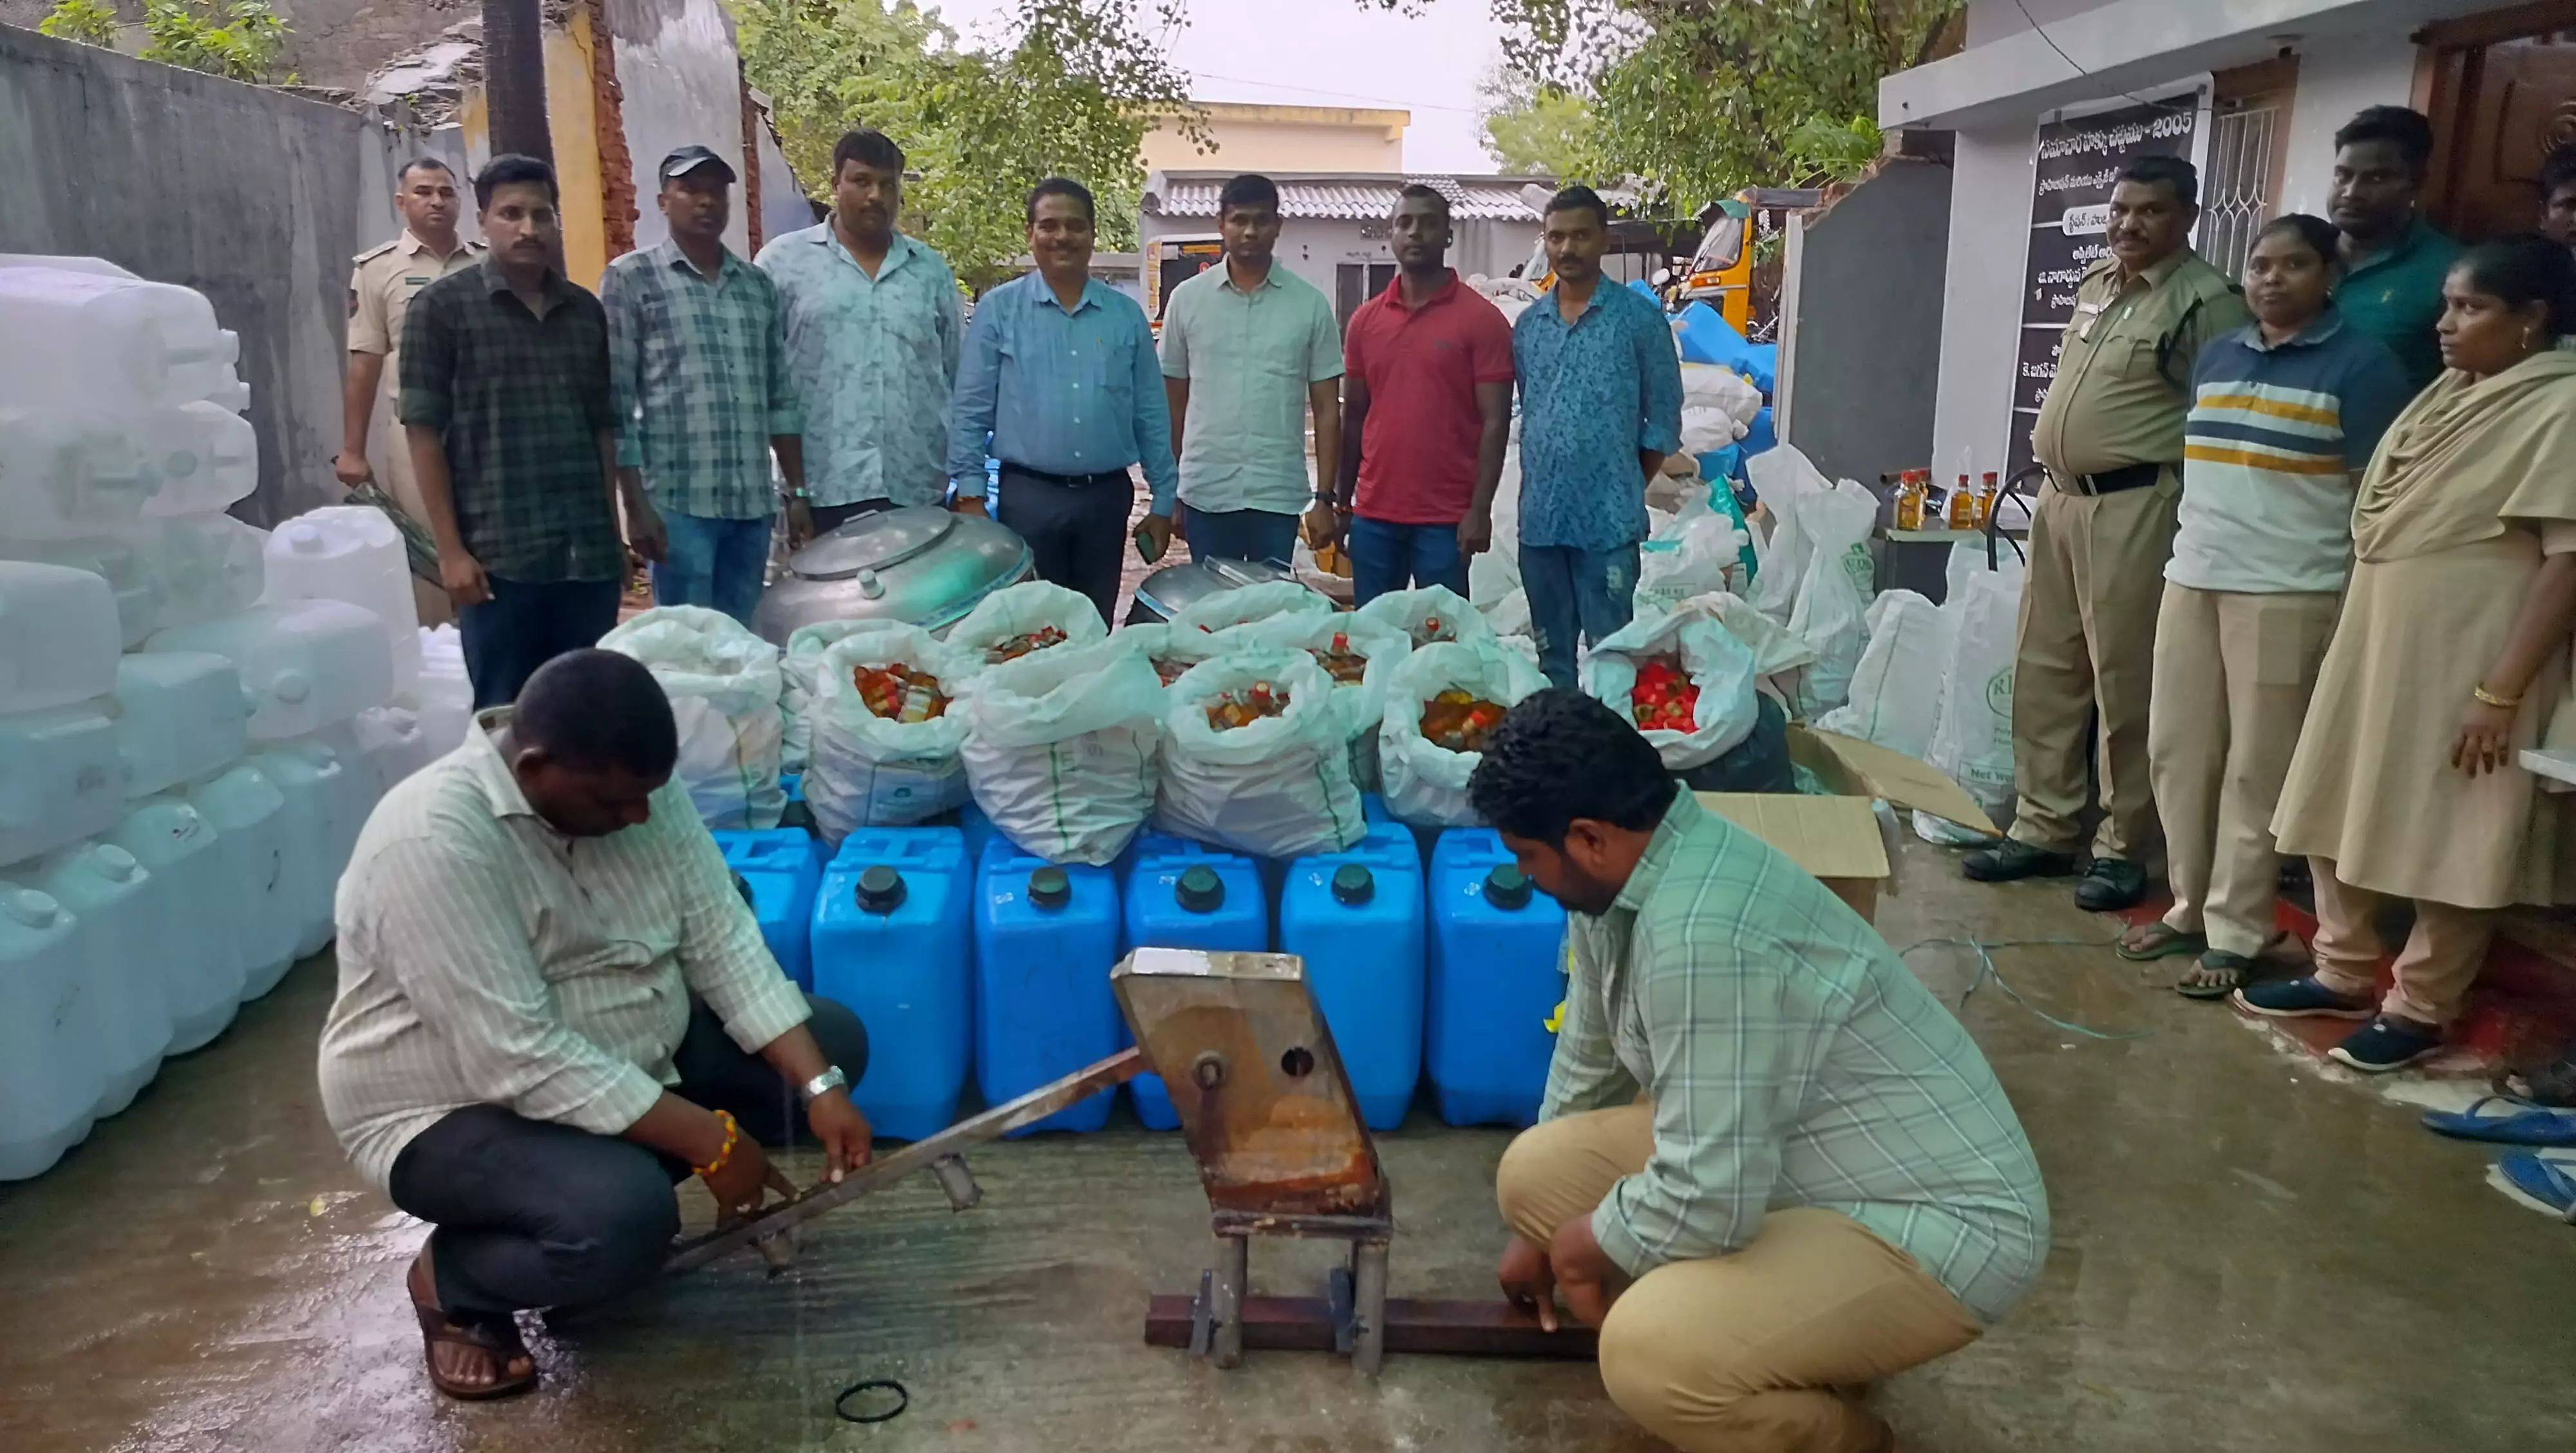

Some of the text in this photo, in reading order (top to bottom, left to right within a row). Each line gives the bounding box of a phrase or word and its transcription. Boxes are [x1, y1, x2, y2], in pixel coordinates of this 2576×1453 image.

[2041, 133, 2082, 160] సమాచార
[2083, 129, 2108, 157] హక్కు
[2109, 122, 2143, 154] చట్టము
[2152, 111, 2192, 139] 2005
